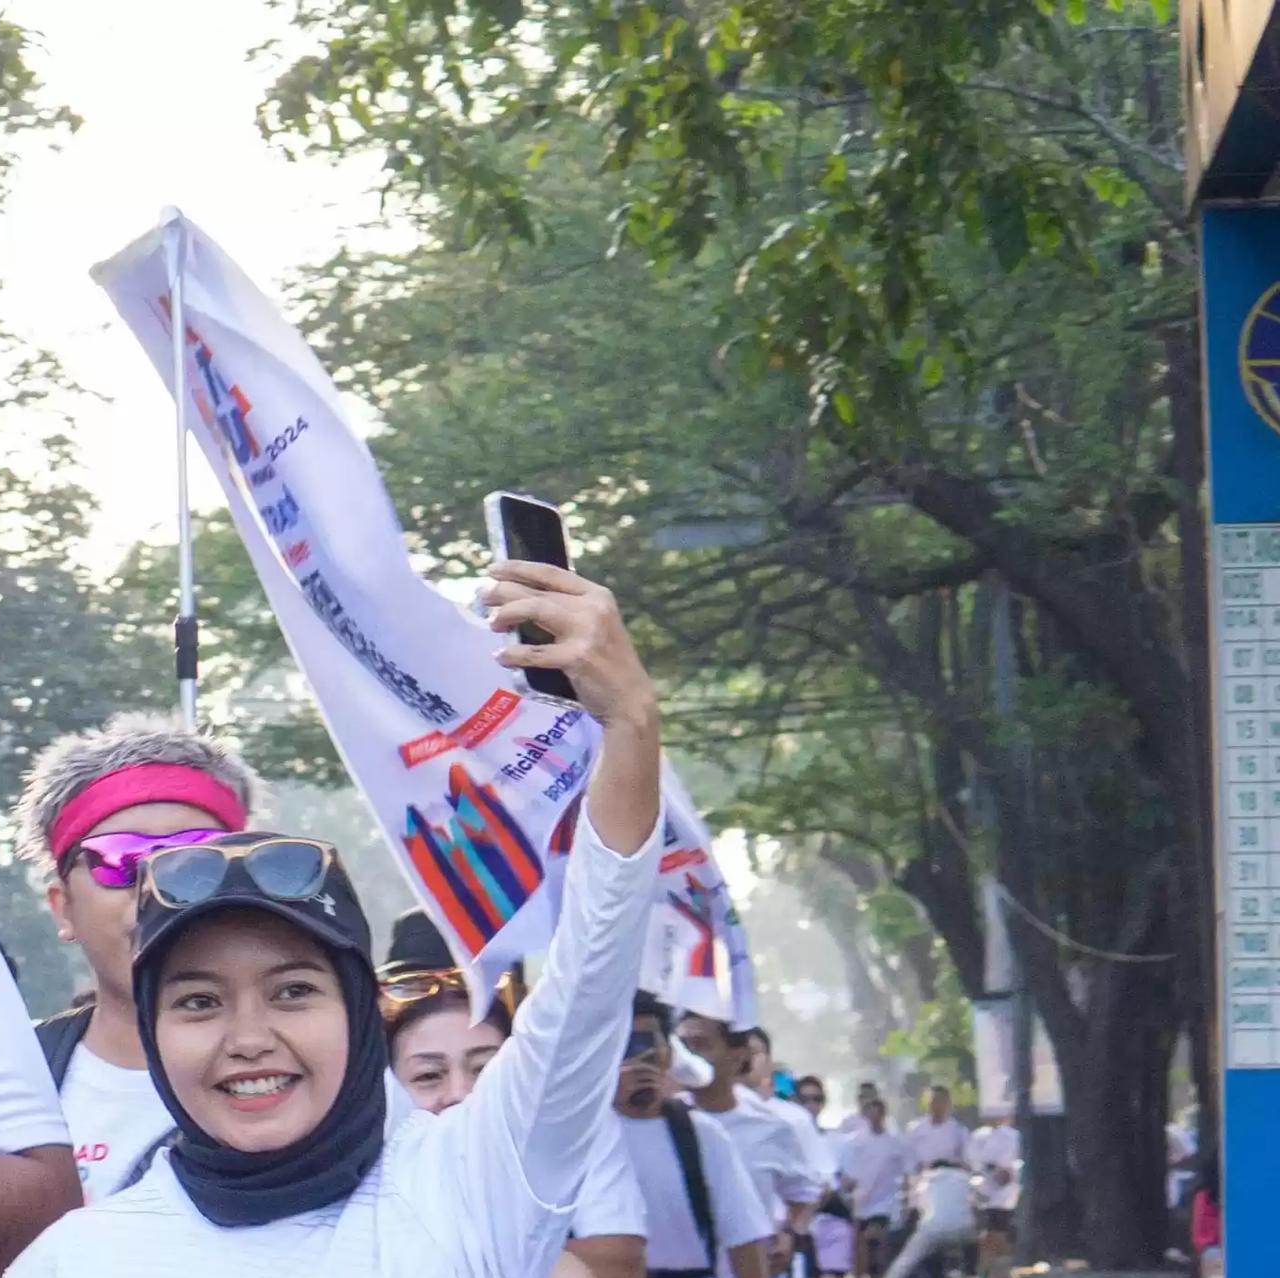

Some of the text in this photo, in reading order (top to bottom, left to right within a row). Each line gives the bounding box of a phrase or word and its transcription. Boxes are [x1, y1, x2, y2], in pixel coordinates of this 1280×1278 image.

[264, 416, 309, 463] 2024
[501, 741, 549, 781] fficial
[75, 1143, 109, 1161] AD
